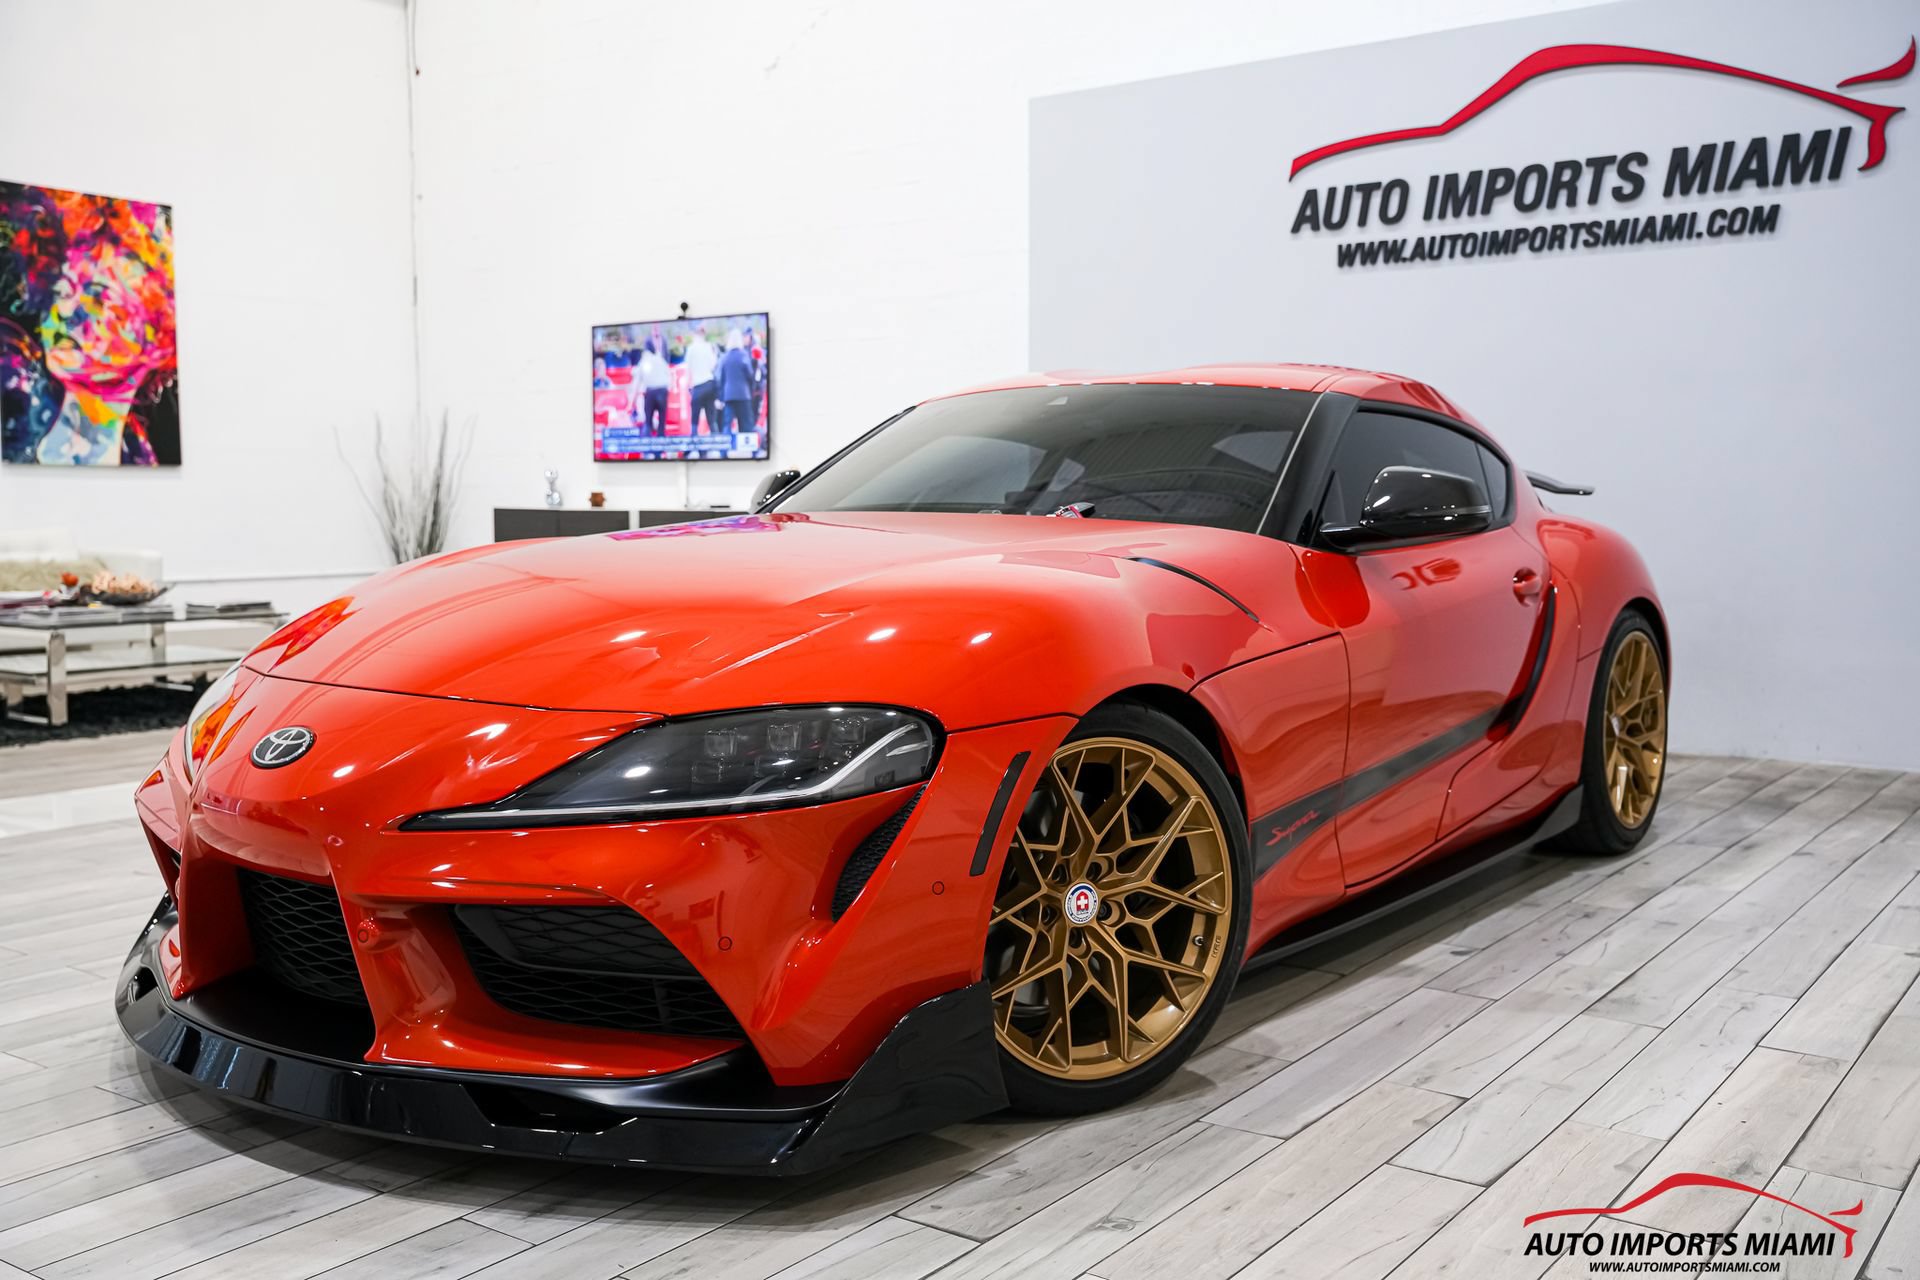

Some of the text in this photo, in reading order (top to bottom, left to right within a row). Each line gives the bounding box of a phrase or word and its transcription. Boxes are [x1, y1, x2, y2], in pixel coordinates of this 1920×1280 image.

[1290, 126, 1853, 235] AUTO IMPORTS MIAMI
[1337, 204, 1781, 268] WWW.AUTOIMPORTSMIAMI.COM
